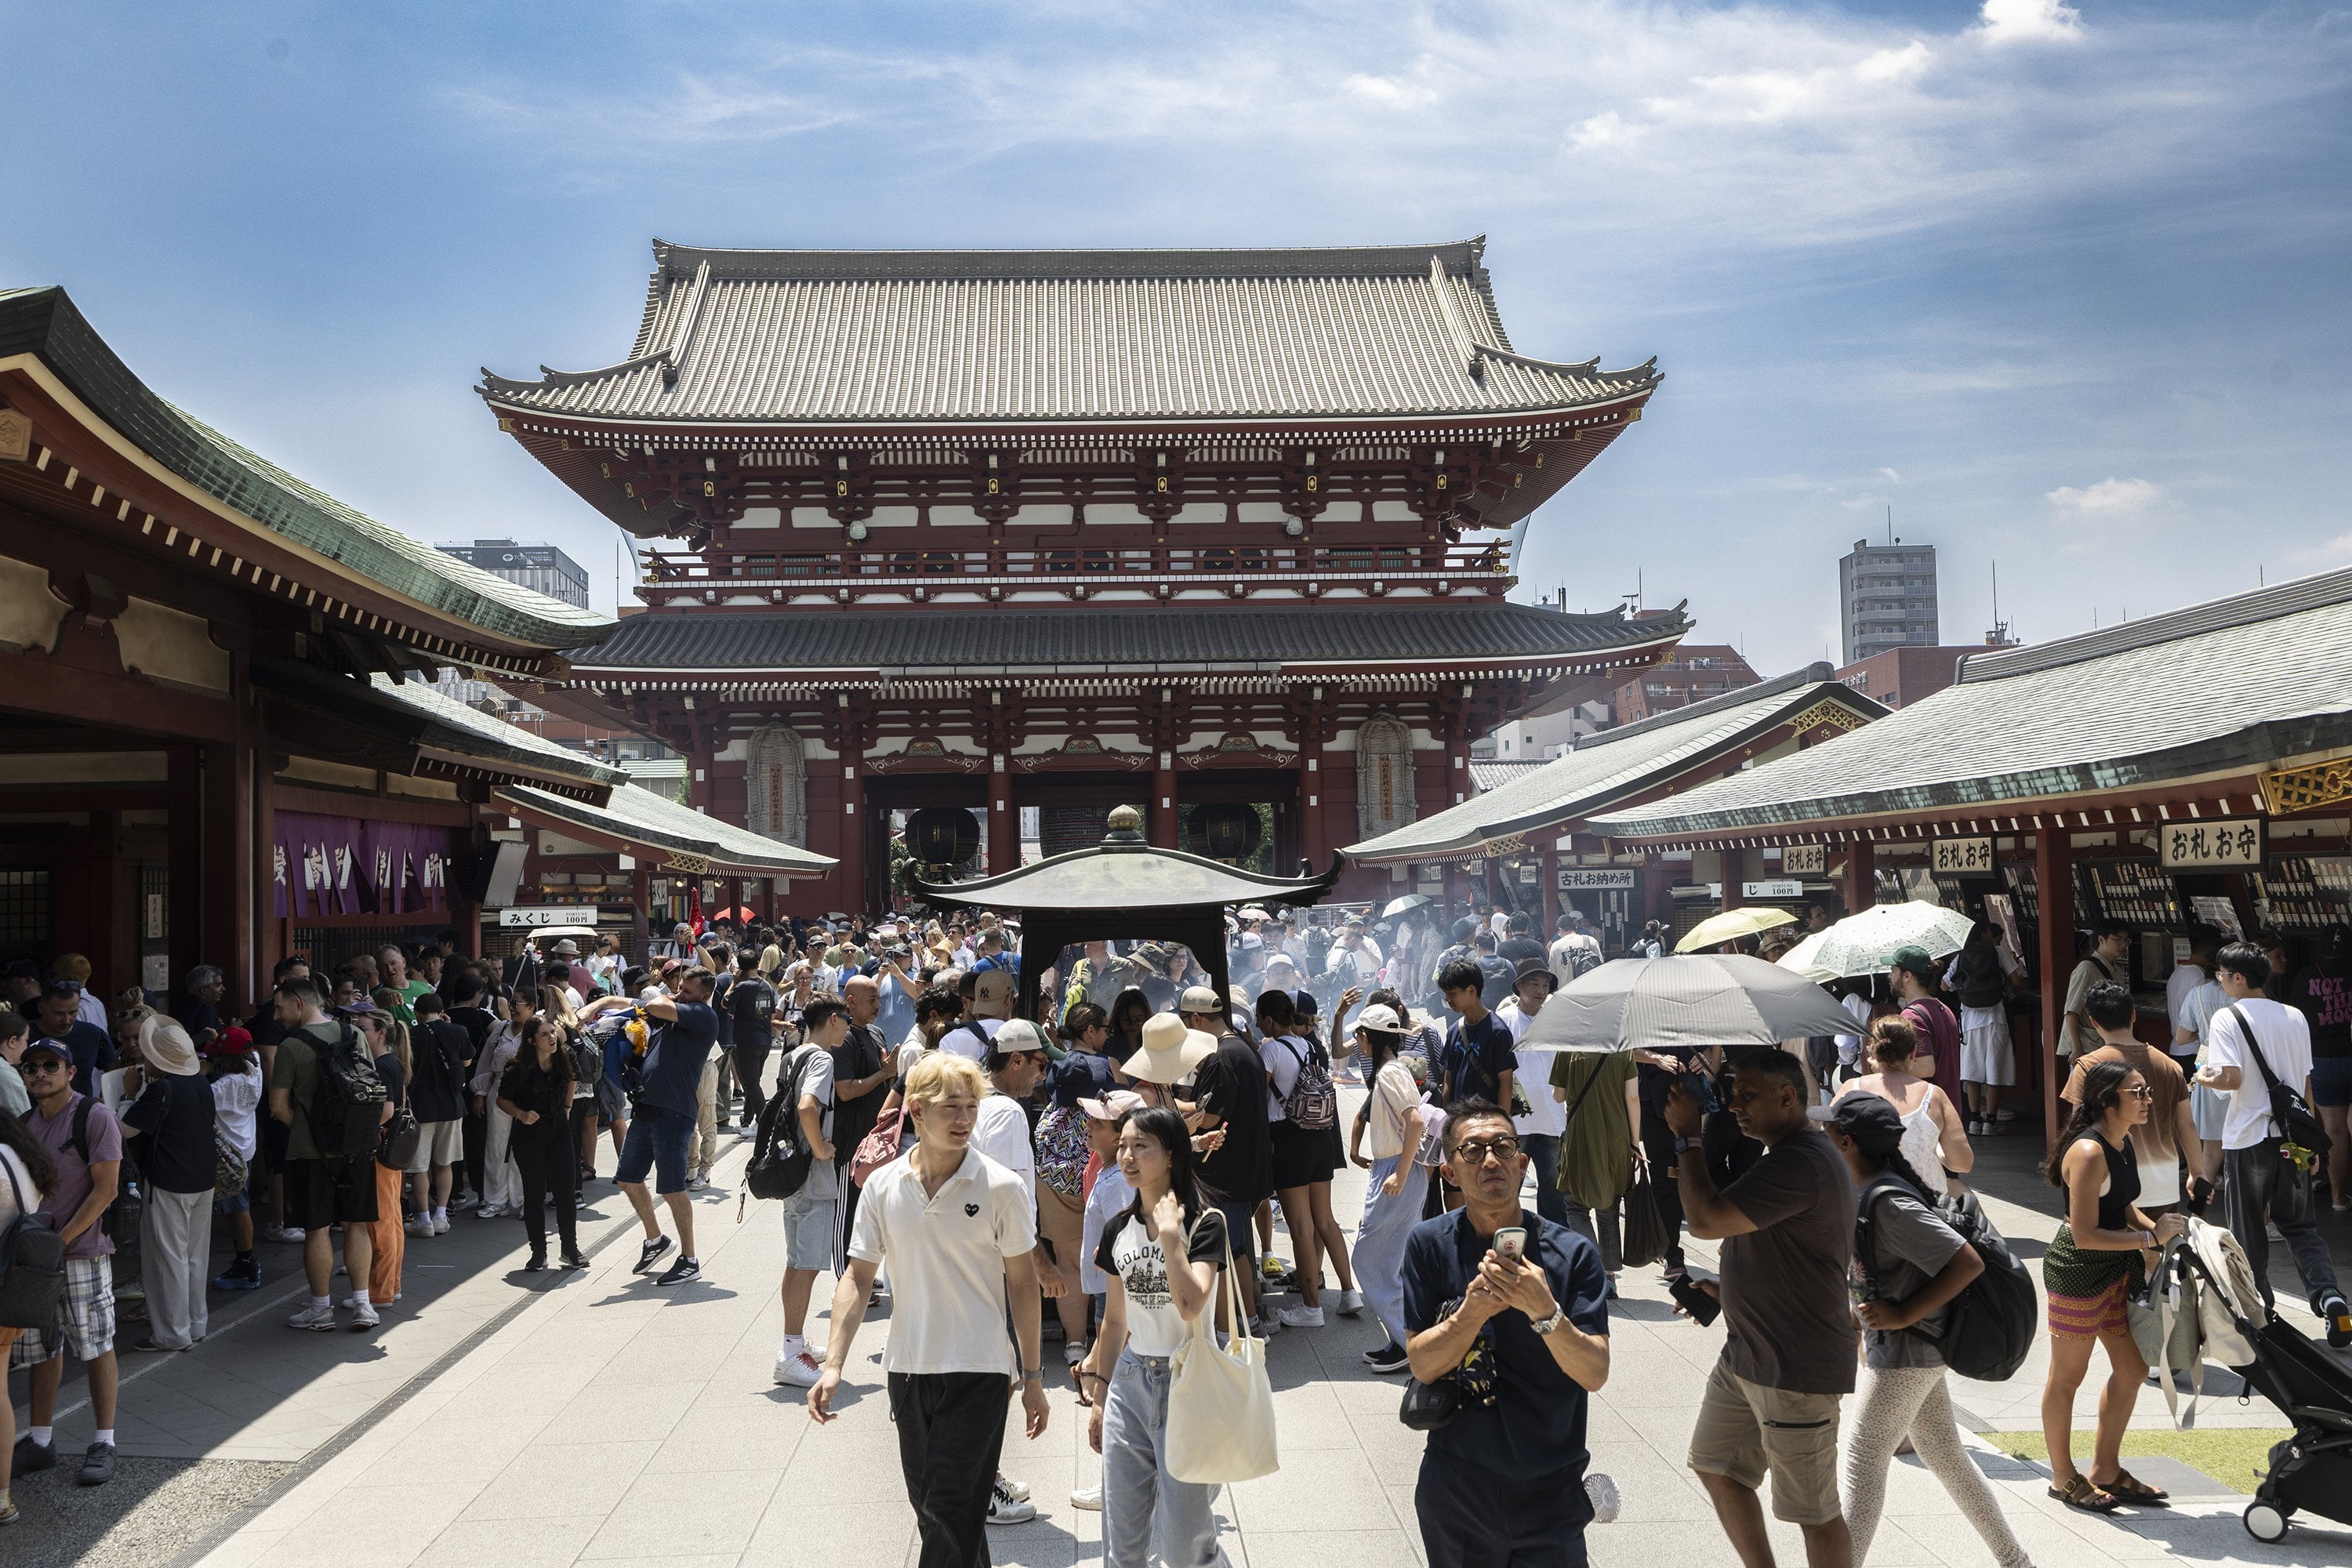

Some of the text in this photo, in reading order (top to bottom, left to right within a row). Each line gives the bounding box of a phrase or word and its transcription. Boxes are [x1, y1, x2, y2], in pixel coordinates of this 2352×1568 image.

[2172, 824, 2256, 862] お札お守
[1787, 848, 1823, 871] お札お守
[1938, 841, 1990, 869] お札お守
[1561, 872, 1631, 886] 古札お納め所
[510, 913, 550, 924] みくじ
[2308, 978, 2343, 996] NOT
